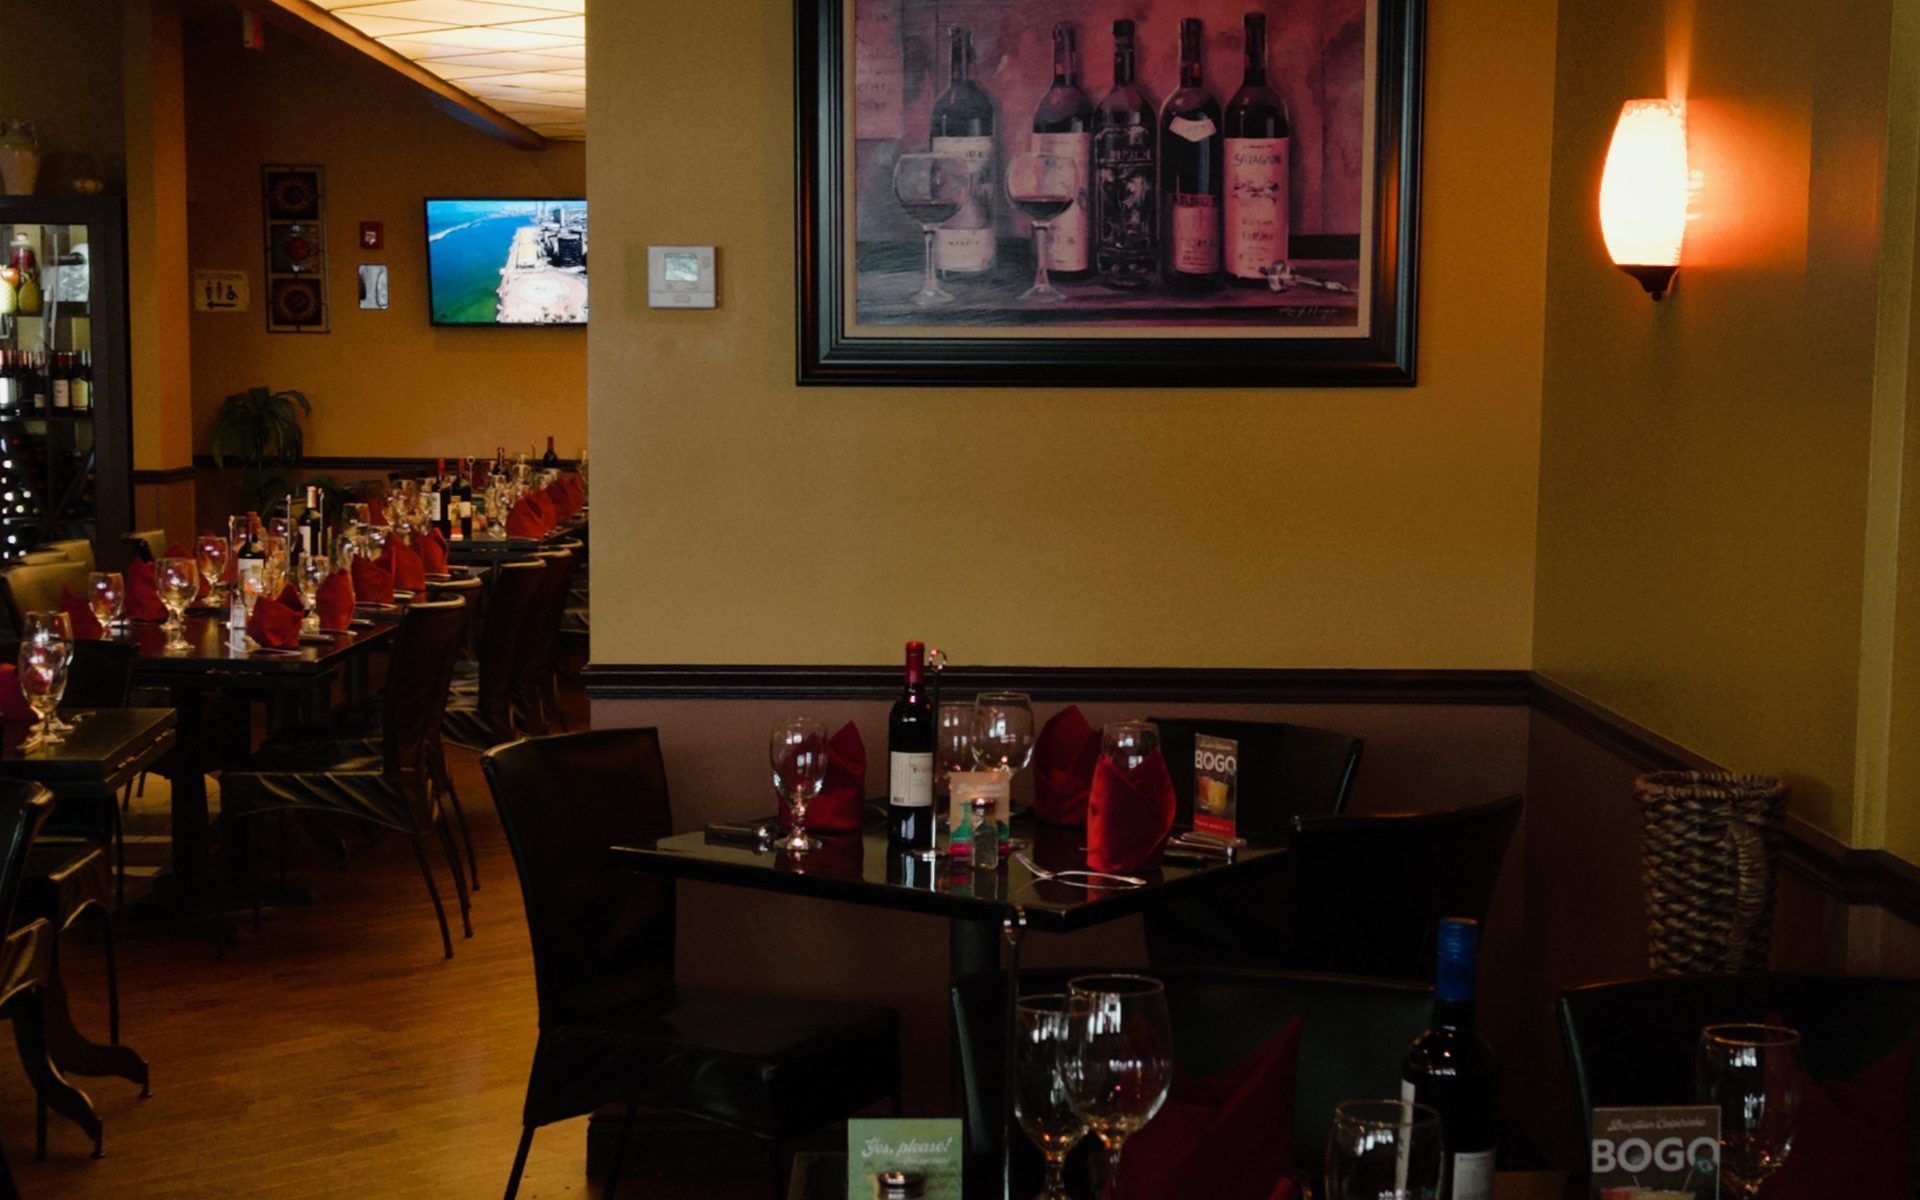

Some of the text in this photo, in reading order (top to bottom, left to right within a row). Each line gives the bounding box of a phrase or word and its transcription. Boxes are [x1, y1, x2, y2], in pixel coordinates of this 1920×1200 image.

[1195, 749, 1237, 773] BOGO
[895, 1136, 953, 1157] please!
[1591, 1136, 1720, 1173] BOGO
